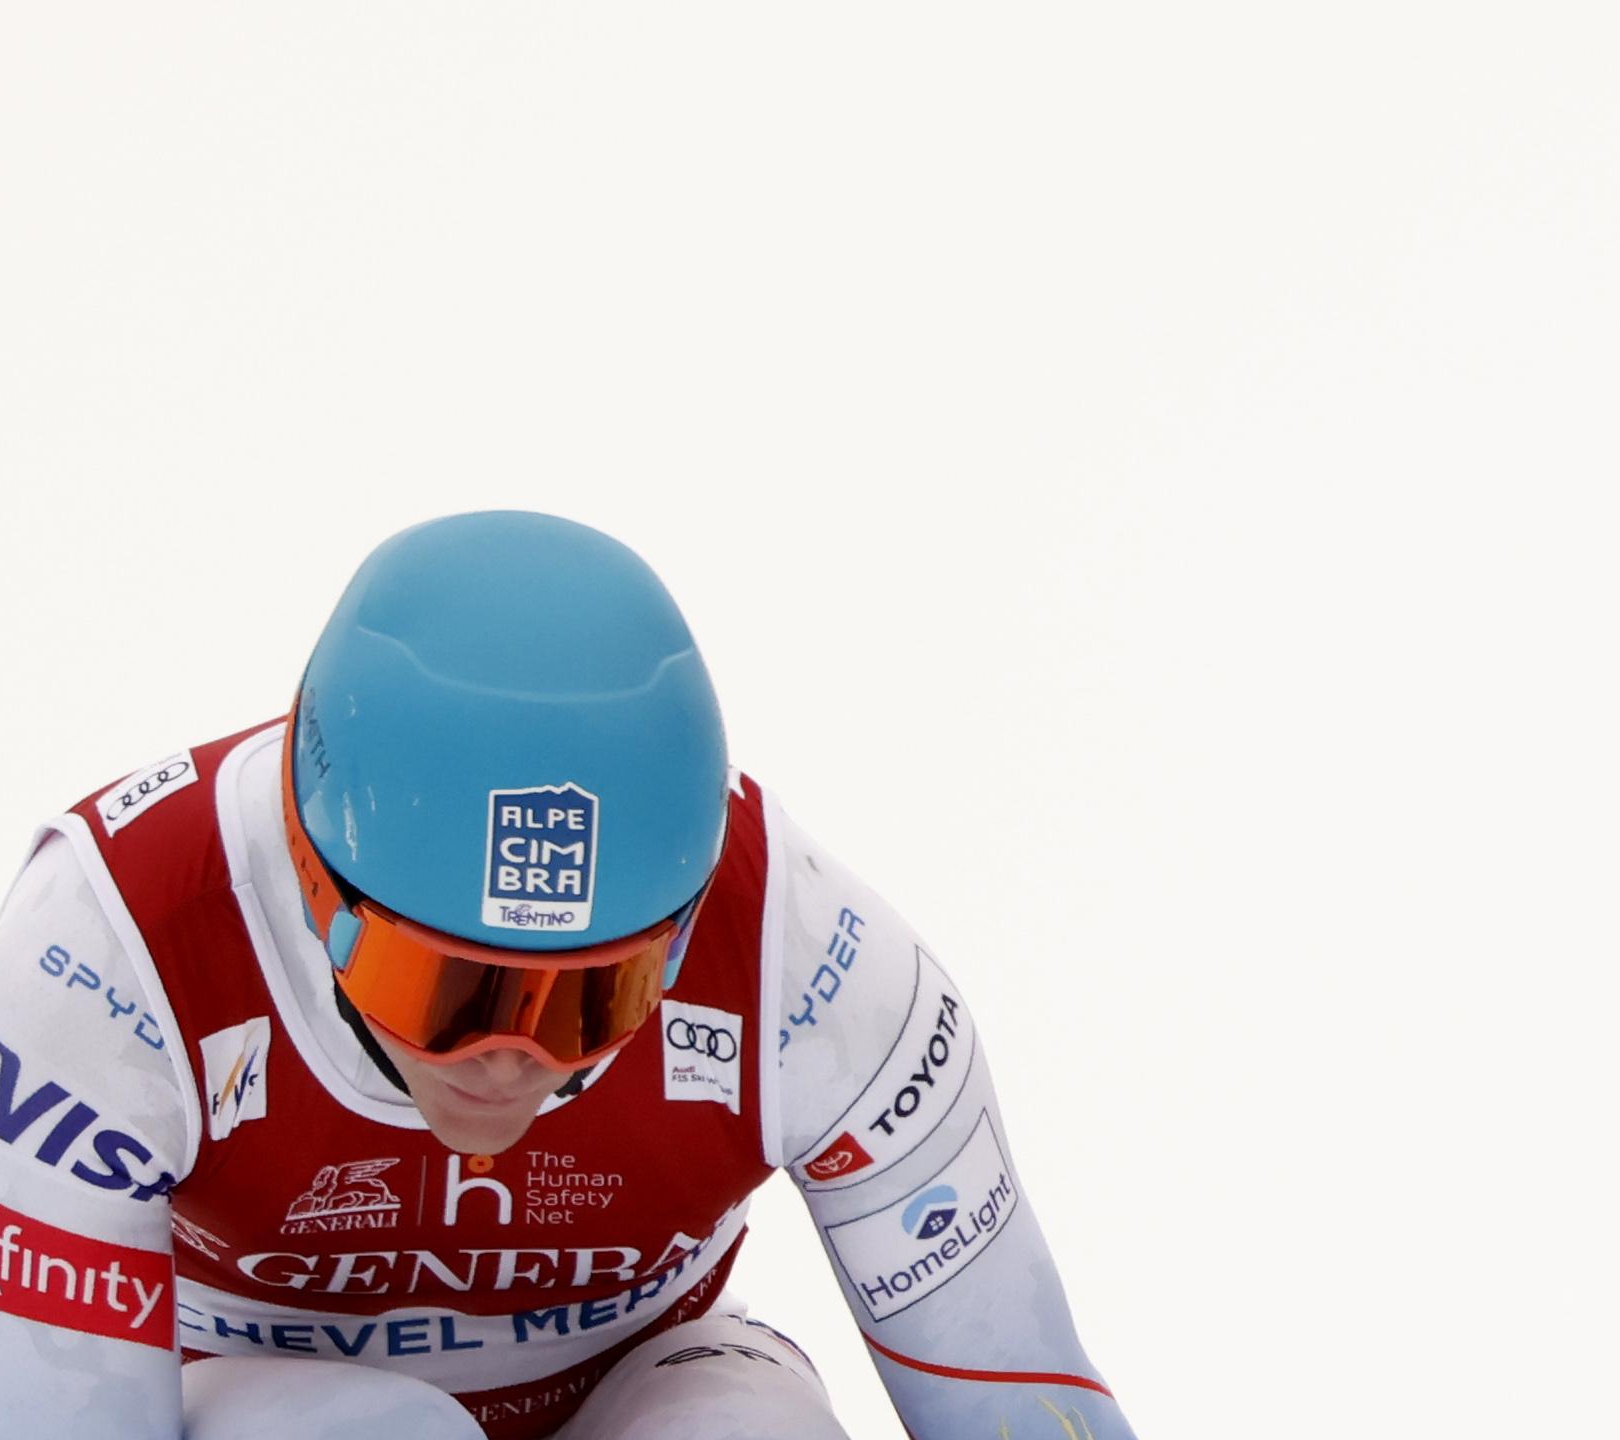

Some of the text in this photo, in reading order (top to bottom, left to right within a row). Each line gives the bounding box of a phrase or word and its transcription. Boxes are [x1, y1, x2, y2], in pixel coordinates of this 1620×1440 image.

[501, 805, 586, 830] ALPE
[499, 837, 585, 866] CIM
[497, 865, 582, 896] BRA
[499, 904, 575, 928] TRENTINO
[868, 993, 959, 1136] TOYOTA
[526, 1151, 576, 1168] The
[526, 1171, 623, 1188] Human
[526, 1190, 614, 1209] Safety
[280, 1212, 400, 1235] GENERALI
[526, 1209, 574, 1224] Net
[860, 1172, 1011, 1306] HomeLight
